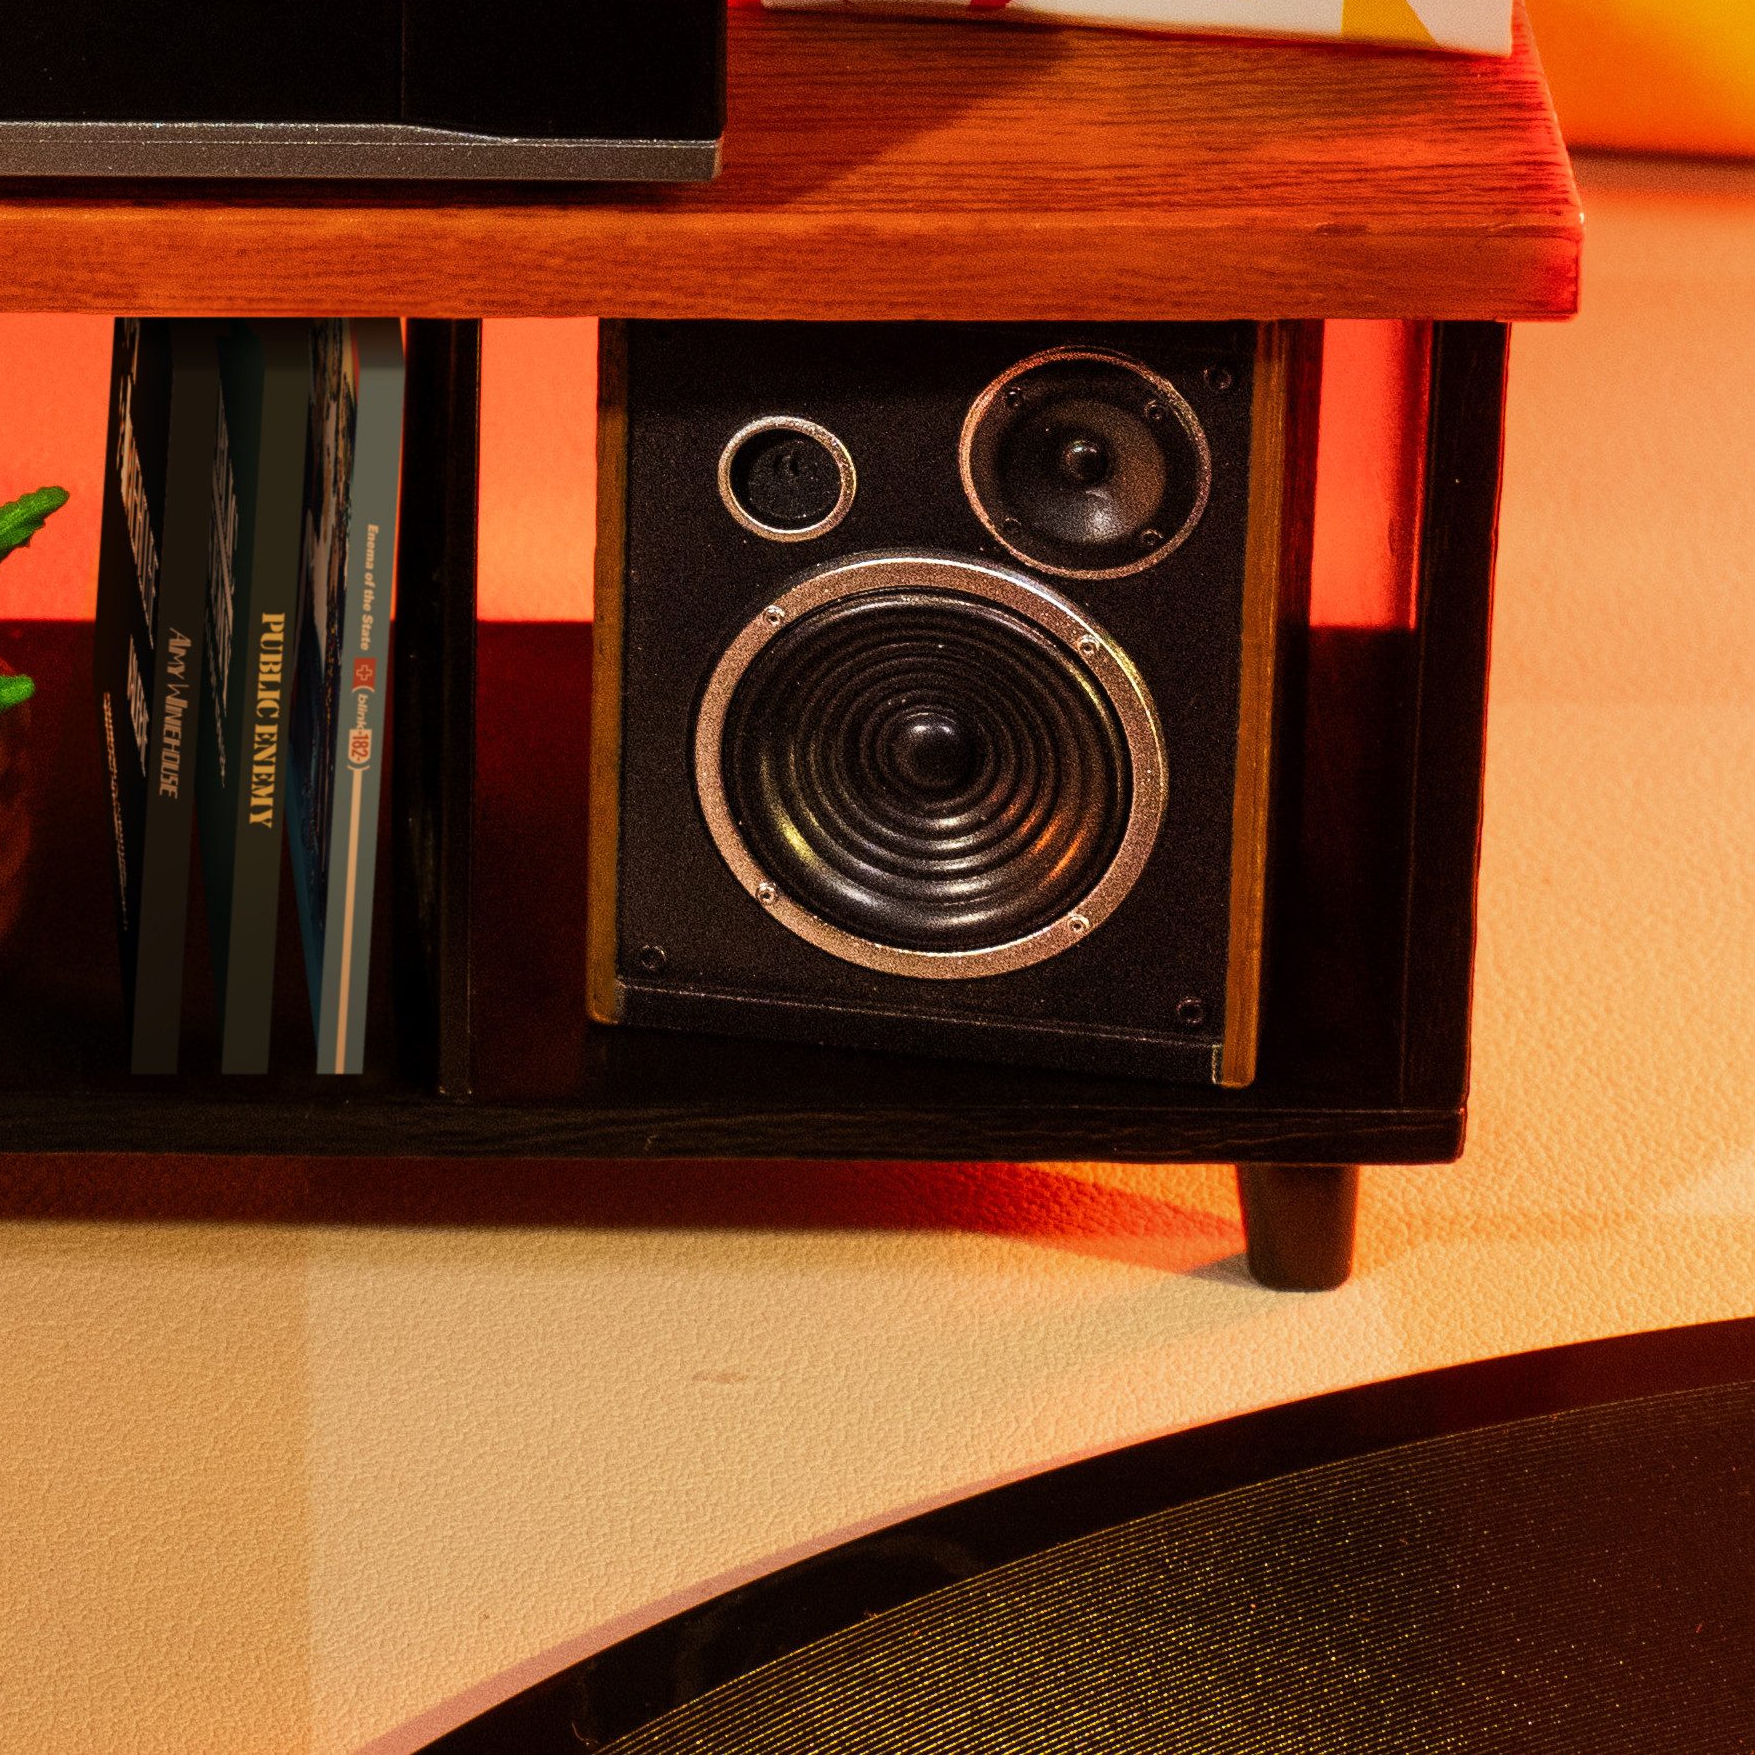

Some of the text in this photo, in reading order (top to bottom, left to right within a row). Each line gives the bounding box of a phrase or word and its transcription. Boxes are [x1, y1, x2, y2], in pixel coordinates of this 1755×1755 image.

[360, 523, 380, 651] Enema of the State
[158, 626, 192, 800] AMY WINEHOUSE
[249, 612, 286, 830] PUBLIC ENEMY
